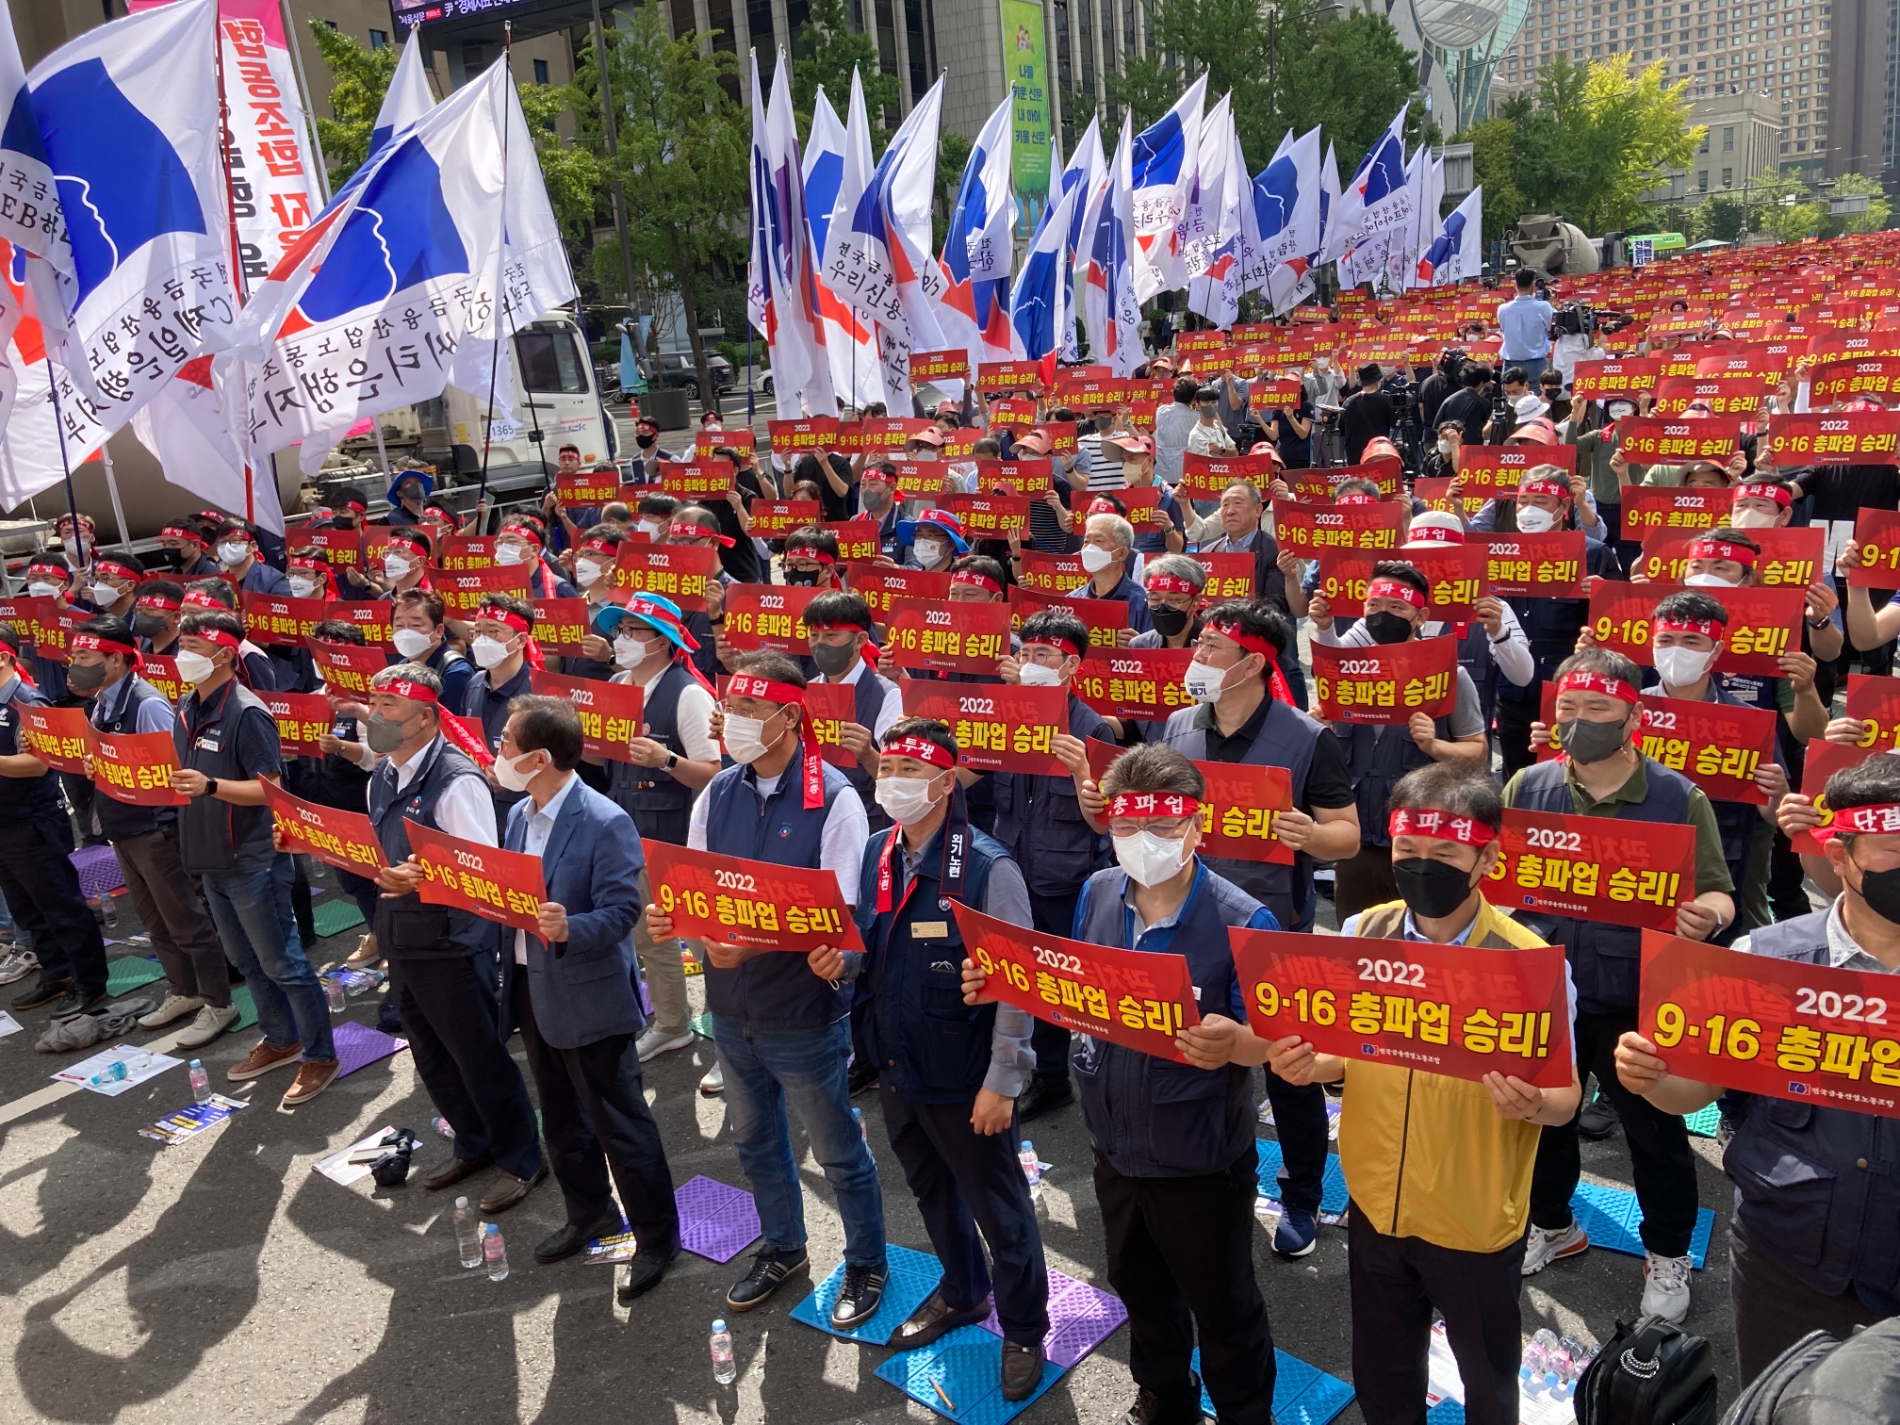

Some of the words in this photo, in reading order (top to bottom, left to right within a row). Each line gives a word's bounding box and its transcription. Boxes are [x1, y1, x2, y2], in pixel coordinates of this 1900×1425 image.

[1019, 64, 1034, 79] 나를
[1028, 88, 1043, 102] 신문
[1018, 108, 1025, 121] 내
[1026, 109, 1041, 123] 아이
[1015, 130, 1030, 144] 키울
[1031, 131, 1046, 145] 신문
[912, 365, 927, 375] 9·16
[930, 364, 948, 373] 총파업
[950, 362, 967, 372] 승리!
[1603, 365, 1622, 373] 2022
[1576, 379, 1594, 389] 9·16
[1599, 377, 1627, 389] 총파업
[1631, 376, 1654, 388] 승리!
[1263, 394, 1279, 403] 총파업
[1282, 394, 1294, 402] 승리!
[492, 424, 514, 436] 1365
[1664, 426, 1689, 435] 2022
[1821, 420, 1848, 430] 2022
[773, 435, 791, 446] 9·16
[794, 434, 815, 445] 총파업
[819, 434, 835, 444] 승리!
[1626, 438, 1653, 452] 9·16
[1659, 439, 1696, 454] 총파업
[1701, 440, 1732, 455] 승리!
[1774, 437, 1808, 451] 9·16
[1814, 436, 1856, 452] 총파업
[1862, 435, 1896, 452] 승리!
[558, 488, 572, 498] 9·16
[575, 489, 595, 499] 총파업
[598, 488, 615, 499] 승리!
[664, 480, 681, 490] 9·16
[685, 479, 706, 491] 총파업
[711, 479, 729, 490] 승리!
[973, 501, 990, 510] 2022
[970, 514, 996, 528] 총파업
[1001, 516, 1024, 529] 승리!
[1316, 514, 1343, 524] 2022
[1279, 525, 1306, 544] 9·16
[1313, 529, 1353, 546] 총파업
[1360, 530, 1395, 548] 승리!
[1489, 543, 1520, 554] 2022
[648, 554, 669, 566] 2022
[1488, 560, 1531, 581] 총파업
[1538, 561, 1577, 582] 승리!
[617, 569, 642, 588] 9·16
[647, 571, 677, 593] 총파업
[681, 575, 706, 597] 승리!
[272, 603, 288, 613] 2022
[761, 595, 784, 608] 2022
[249, 615, 267, 629] 9·16
[272, 618, 296, 634] 총파업
[725, 613, 751, 632] 9·16
[757, 614, 791, 636] 총파업
[926, 611, 951, 625] 2022
[888, 628, 916, 648] 9·16
[922, 630, 960, 654] 총파업
[966, 635, 1001, 657] 승리!
[1596, 617, 1648, 644] 9·16
[1732, 627, 1789, 655] 승리!
[1111, 660, 1143, 673] 2022
[1341, 660, 1380, 674] 2022
[1110, 679, 1156, 703] 총파업
[1337, 680, 1395, 706] 총파업
[1404, 673, 1448, 706] 승리!
[959, 697, 994, 714] 2022
[956, 720, 1006, 750] 총파업
[1014, 725, 1058, 753] 승리!
[100, 742, 118, 758] 2022
[1696, 745, 1759, 778] 승리!
[105, 761, 134, 788] 총파업
[138, 765, 173, 791] 승리!
[1109, 795, 1182, 815] 총파업
[297, 807, 324, 826] 2022
[1223, 807, 1279, 839] 승리!
[1395, 811, 1472, 840] 총파업
[274, 811, 304, 841] 9·16
[309, 829, 340, 855] 총파업
[346, 841, 381, 869] 승리!
[1527, 829, 1581, 851] 2022
[454, 849, 484, 871] 2022
[948, 833, 963, 878] 외기노련
[423, 860, 456, 888] 9·16
[460, 871, 503, 904] 총파업
[505, 888, 540, 917] 승리!
[715, 870, 756, 892] 2022
[1517, 854, 1598, 896] 총파업
[1609, 868, 1679, 906] 승리!
[661, 885, 708, 917] 9·16
[717, 895, 778, 930] 총파업
[786, 907, 843, 933] 승리!
[1034, 943, 1085, 973] 2022
[1358, 958, 1426, 987] 2022
[977, 949, 1029, 990] 9·16
[1037, 973, 1109, 1019] 총파업
[1119, 996, 1181, 1035] 승리!
[1797, 991, 1887, 1024] 2022
[1256, 983, 1335, 1025] 9·16
[1349, 992, 1449, 1044] 총파업
[1464, 1009, 1550, 1057] 승리!
[1378, 1044, 1441, 1066] 전국금융산업노동조합
[1654, 1003, 1760, 1059] 9·16
[1777, 1024, 1900, 1088] 총파업
[1811, 1085, 1894, 1108] 전국금융산업노동조합
